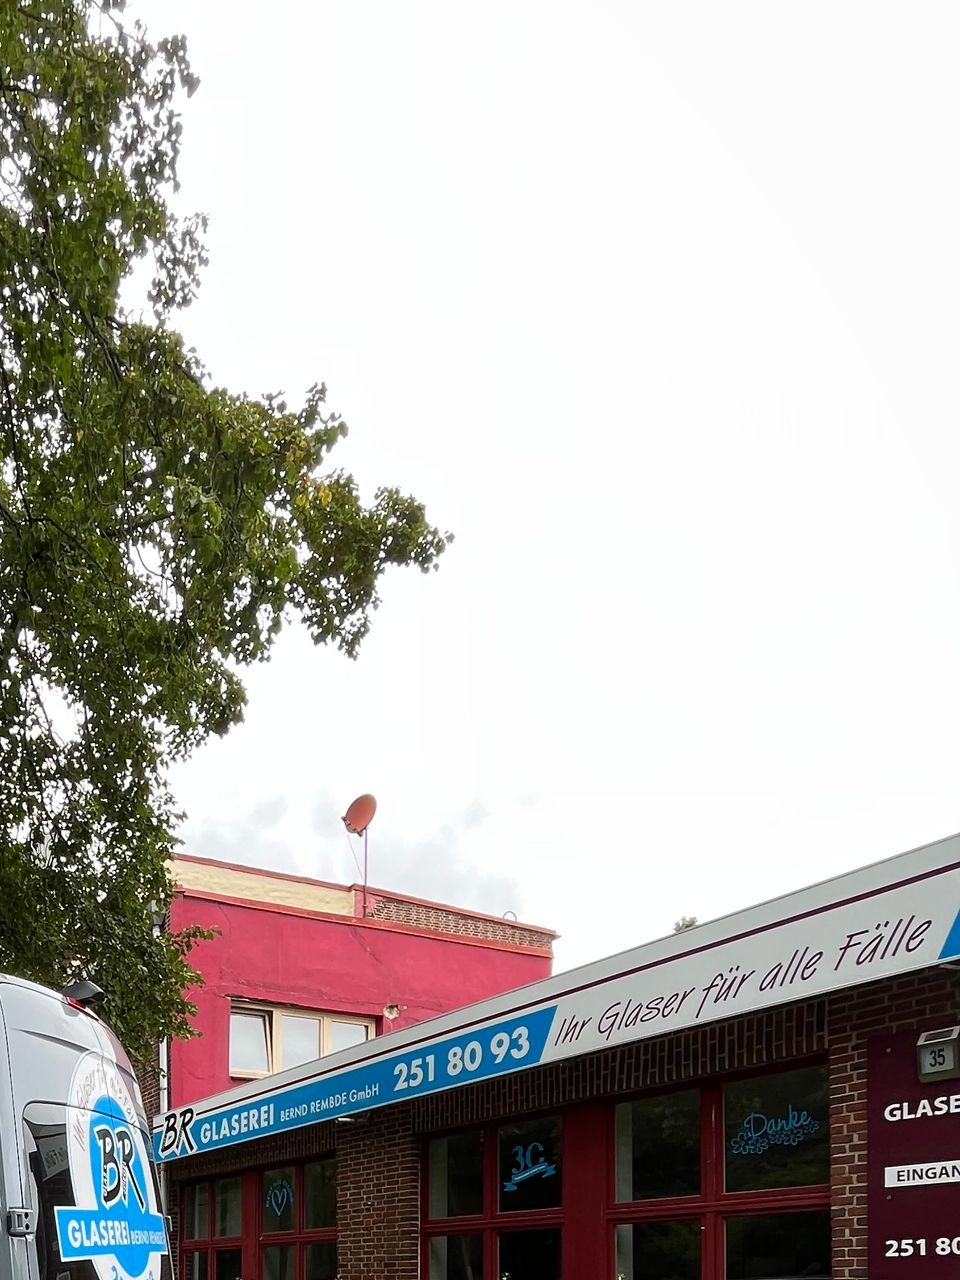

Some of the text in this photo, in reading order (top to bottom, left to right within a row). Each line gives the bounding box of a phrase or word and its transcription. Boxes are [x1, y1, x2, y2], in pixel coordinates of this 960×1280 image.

[554, 915, 932, 1046] Ihr Glaser für alle Fälle
[929, 1048, 946, 1068] 35
[161, 1026, 530, 1153] BR GLASEREI BERND REMBDE GmbH 251 80 93
[743, 1104, 811, 1140] Danke
[96, 1128, 144, 1209] BR
[68, 1219, 130, 1248] GLASEREI
[885, 1239, 926, 1257] 251
